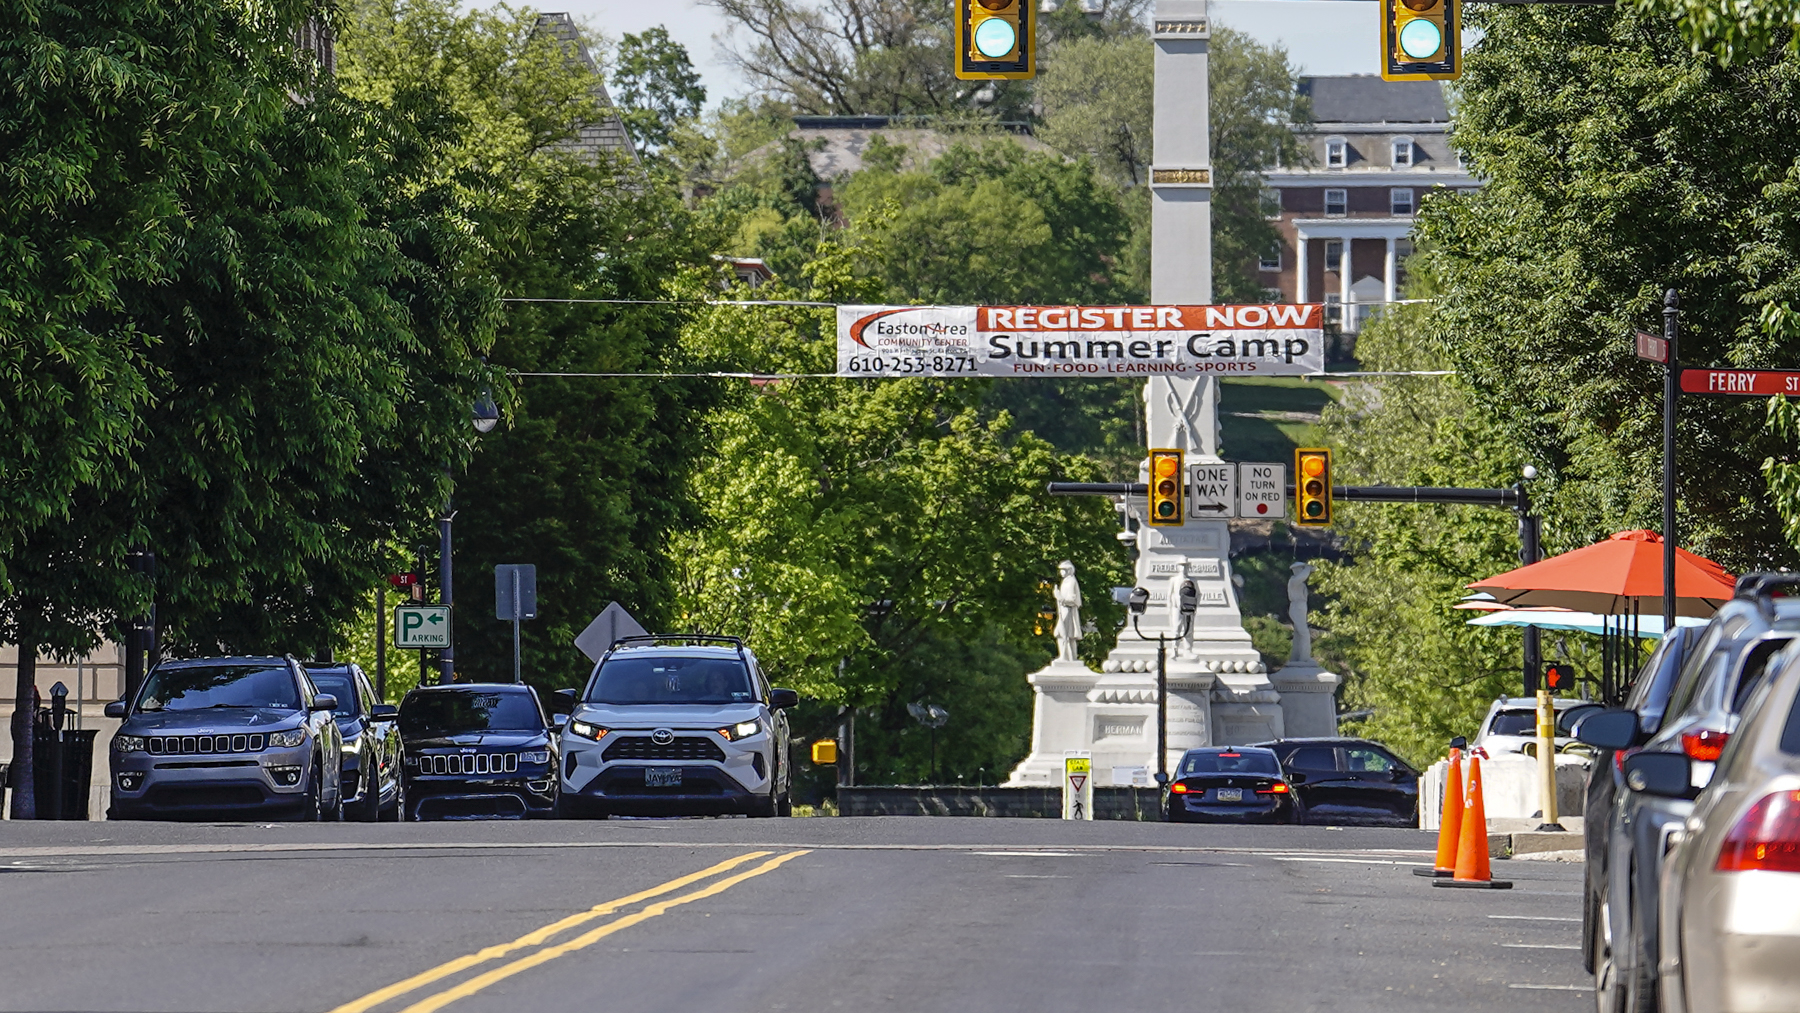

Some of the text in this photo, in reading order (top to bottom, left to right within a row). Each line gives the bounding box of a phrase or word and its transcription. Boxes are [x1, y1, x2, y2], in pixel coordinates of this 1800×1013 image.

[987, 305, 1313, 329] REGISTER NOW
[877, 321, 967, 335] Easton Area
[878, 338, 968, 347] COMMUNITY CENTER
[988, 333, 1310, 364] Summer Camp
[849, 356, 978, 373] 610-253-8271
[1708, 372, 1799, 391] FERRY ST
[1196, 468, 1228, 482] ONE
[1253, 467, 1272, 479] NO
[1196, 484, 1229, 497] WAY
[1250, 480, 1276, 490] TURN
[1245, 492, 1280, 502] ON RED
[400, 576, 408, 584] ST
